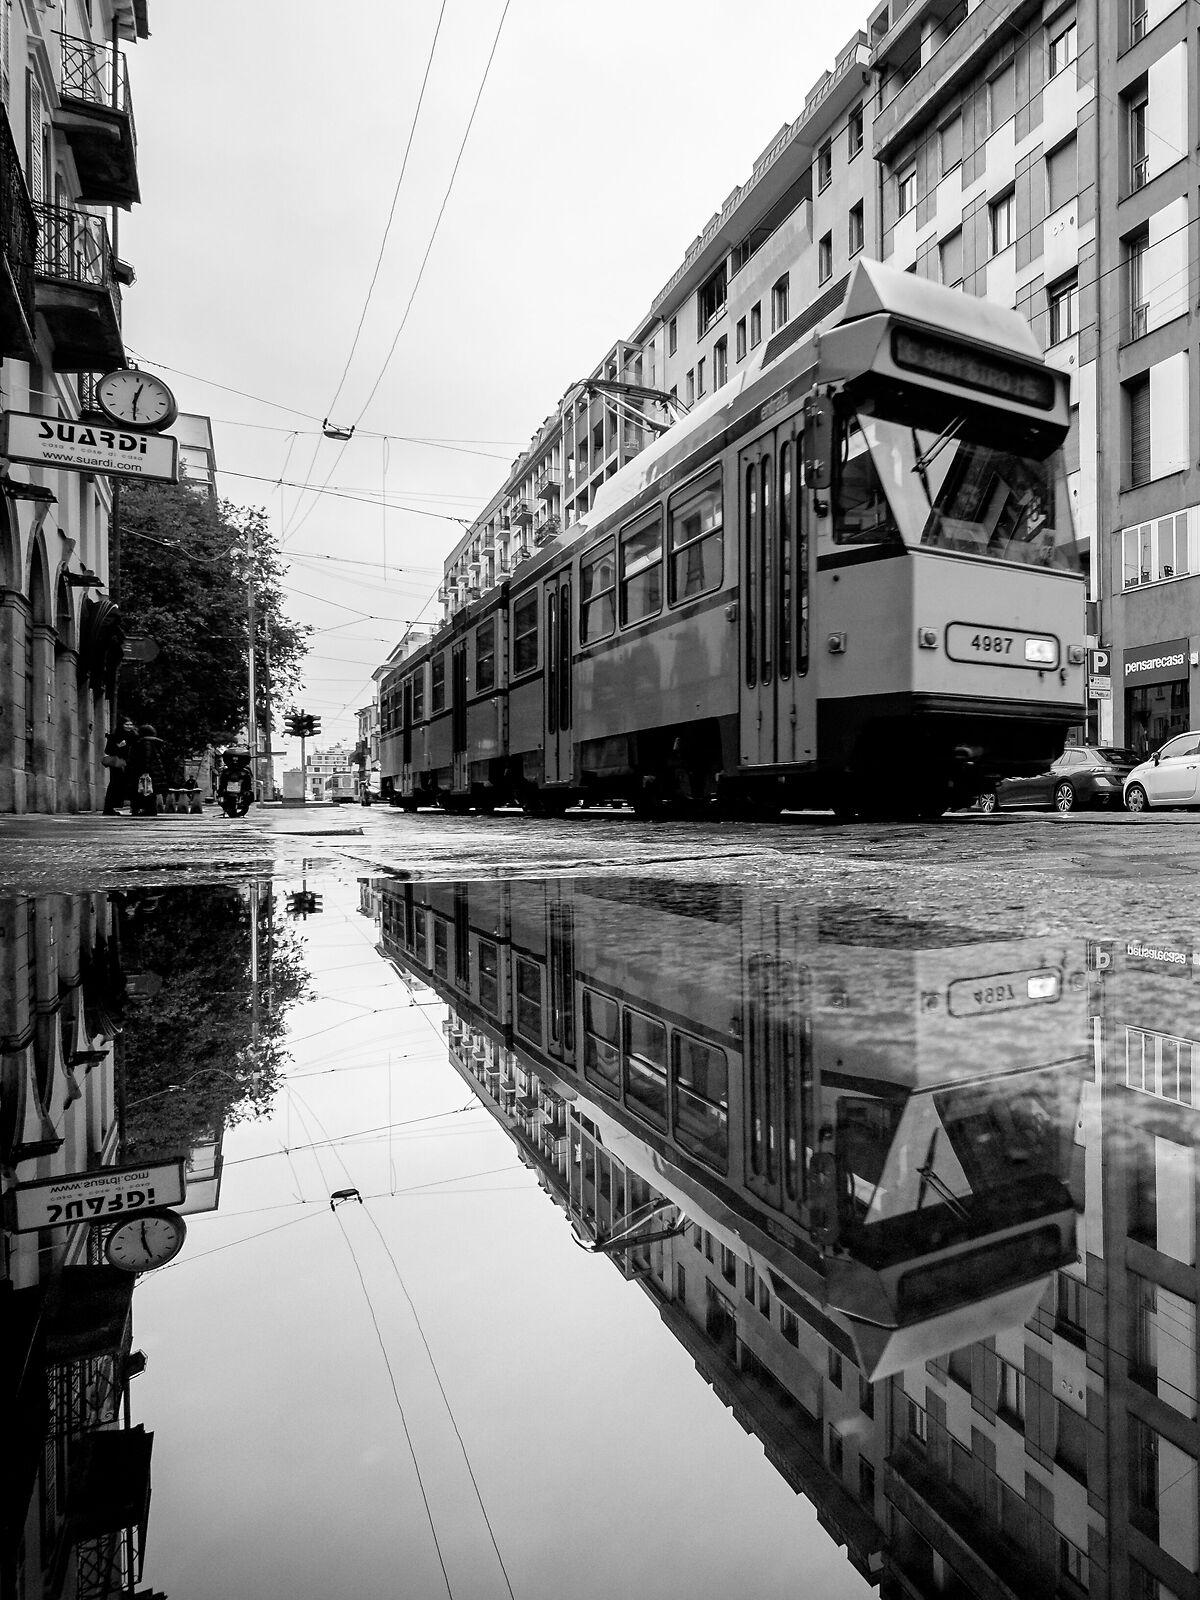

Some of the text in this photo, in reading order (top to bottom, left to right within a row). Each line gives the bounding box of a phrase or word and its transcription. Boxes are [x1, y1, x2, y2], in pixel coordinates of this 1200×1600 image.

[41, 442, 65, 450] casa
[80, 447, 103, 455] cose
[42, 451, 142, 472] www.suardi.com
[970, 634, 1014, 654] 4987
[1125, 653, 1184, 676] pensarecasa
